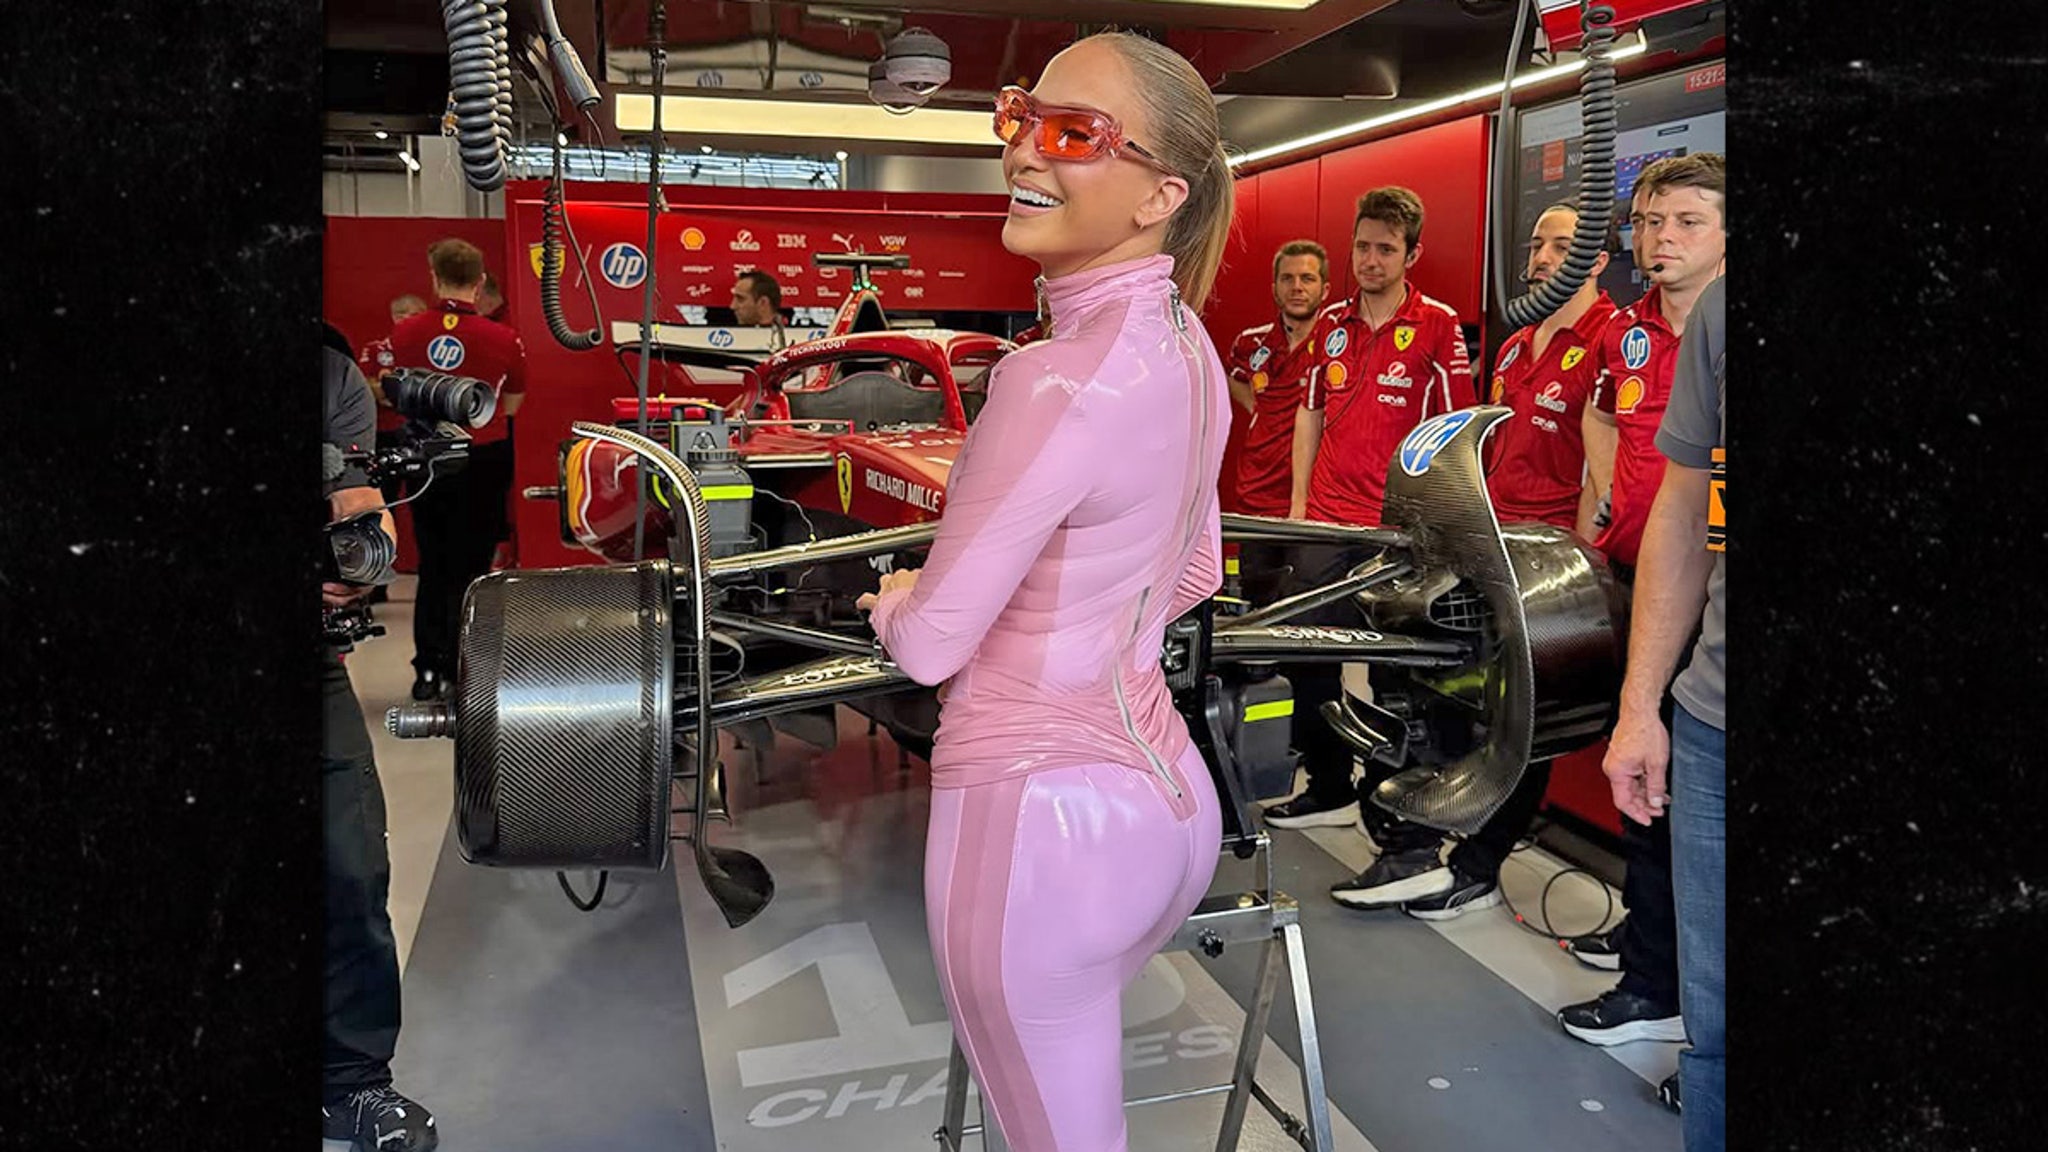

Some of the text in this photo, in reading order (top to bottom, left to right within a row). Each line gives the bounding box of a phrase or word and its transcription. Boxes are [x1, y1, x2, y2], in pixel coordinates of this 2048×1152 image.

[777, 234, 807, 248] IBM
[879, 235, 907, 247] VGW
[607, 244, 643, 286] hp
[433, 336, 461, 368] hp
[711, 331, 733, 346] hp
[789, 338, 848, 358] TECHNOLOGY
[1625, 327, 1647, 368] hp
[1404, 418, 1464, 472] hp
[866, 468, 943, 513] RICHARD MILLE
